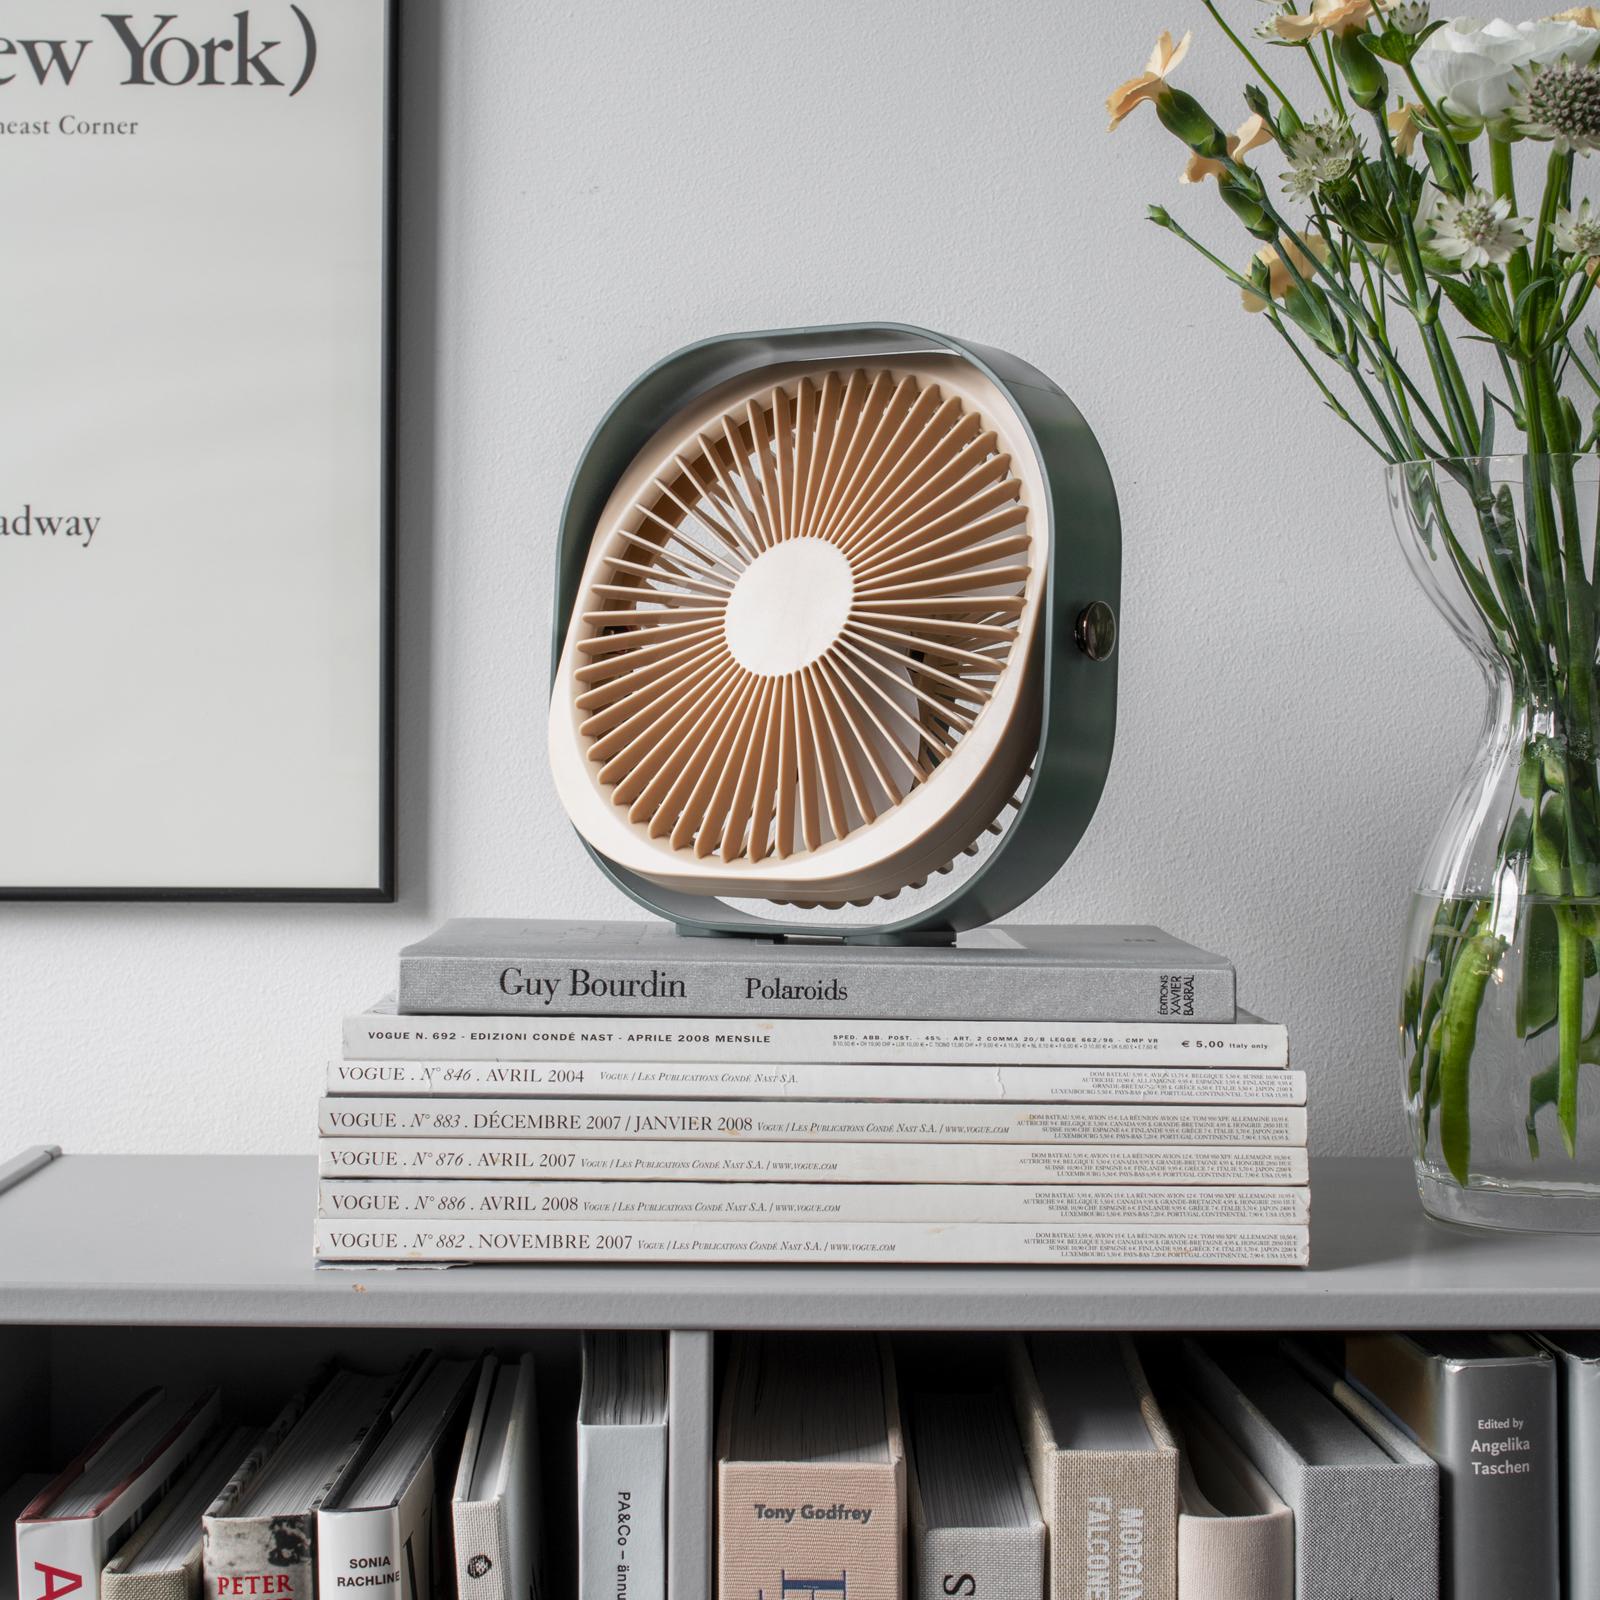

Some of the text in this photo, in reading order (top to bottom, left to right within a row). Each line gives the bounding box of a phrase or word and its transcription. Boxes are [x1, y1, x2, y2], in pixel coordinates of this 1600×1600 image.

[100, 3, 318, 97] York)
[58, 115, 139, 135] Corner
[0, 504, 101, 548] adway
[499, 967, 848, 1006] Guy Bourdin Polaroids
[1157, 974, 1169, 1015] ÉDITIONS
[1170, 976, 1182, 1015] XAVIER
[1183, 975, 1195, 1016] BARRAL
[368, 1031, 410, 1040] VOGUE
[415, 1032, 429, 1040] N.
[432, 1032, 456, 1040] 692
[470, 1032, 527, 1041] EDIZIONI
[532, 1031, 576, 1042] CONDÉ
[580, 1033, 614, 1042] NAST
[627, 1034, 673, 1042] APRILE
[677, 1034, 710, 1043] 2008
[715, 1034, 771, 1043] MENSILE
[1181, 1040, 1190, 1048] €
[1229, 1042, 1248, 1050] Italy
[338, 1066, 585, 1083] VOGUE N° 846 AVRIL 2004
[600, 1071, 630, 1081] VOGUE
[637, 1071, 656, 1081] LES
[658, 1072, 719, 1082] PUBLICATIONS
[720, 1073, 752, 1083] CONDÉ
[754, 1073, 779, 1083] NAST
[329, 1112, 397, 1128] VOGUE
[409, 1113, 431, 1128] N°
[433, 1114, 461, 1129] 883
[474, 1110, 581, 1130] DÉCEMBRE
[586, 1115, 622, 1130] 2007
[633, 1115, 713, 1133] JANVIER
[717, 1116, 753, 1132] 2008
[757, 1121, 786, 1132] VOGUE
[791, 1121, 808, 1132] LES
[809, 1122, 865, 1133] PUBLICATIONS
[865, 1122, 895, 1133] CONDÉ
[895, 1122, 919, 1133] NAST
[919, 1123, 938, 1133] S.A.
[330, 1151, 576, 1168] VOGUE N° 876 AVRIL 2007
[581, 1158, 609, 1168] VOGUE
[615, 1158, 633, 1168] LES
[634, 1158, 689, 1169] PUBLICATIONS
[691, 1159, 720, 1169] CONDÉ
[722, 1159, 745, 1169] NAST
[745, 1160, 765, 1170] S.A.
[332, 1195, 579, 1211] VOGUE N° 886 AVRIL 2008
[583, 1201, 612, 1212] VOGUE
[617, 1201, 635, 1212] LES
[636, 1201, 692, 1212] PUBLICATIONS
[694, 1202, 723, 1212] CONDÉ
[724, 1201, 747, 1212] NAST
[748, 1202, 767, 1212] S.A.
[330, 1233, 633, 1250] VOGUE N° 882 NOVEMBRE 2007
[638, 1239, 666, 1250] VOGUE
[671, 1240, 690, 1250] LES
[691, 1240, 746, 1251] PUBLICATIONS
[748, 1240, 778, 1251] CONDÉ
[779, 1240, 803, 1251] NAST
[805, 1241, 823, 1251] S.A.
[1477, 1416, 1525, 1431] Edited by
[1470, 1437, 1532, 1457] Angelika
[1471, 1459, 1531, 1475] Taschen
[617, 1491, 631, 1546] PA&Co
[754, 1504, 873, 1525] Tony Godfrey
[1087, 1496, 1111, 1600] FALCONE
[1119, 1508, 1144, 1600] MORGAN
[349, 1555, 391, 1569] SONIA
[34, 1560, 83, 1600] A
[217, 1574, 294, 1595] PETER
[337, 1571, 401, 1587] RACHLINE
